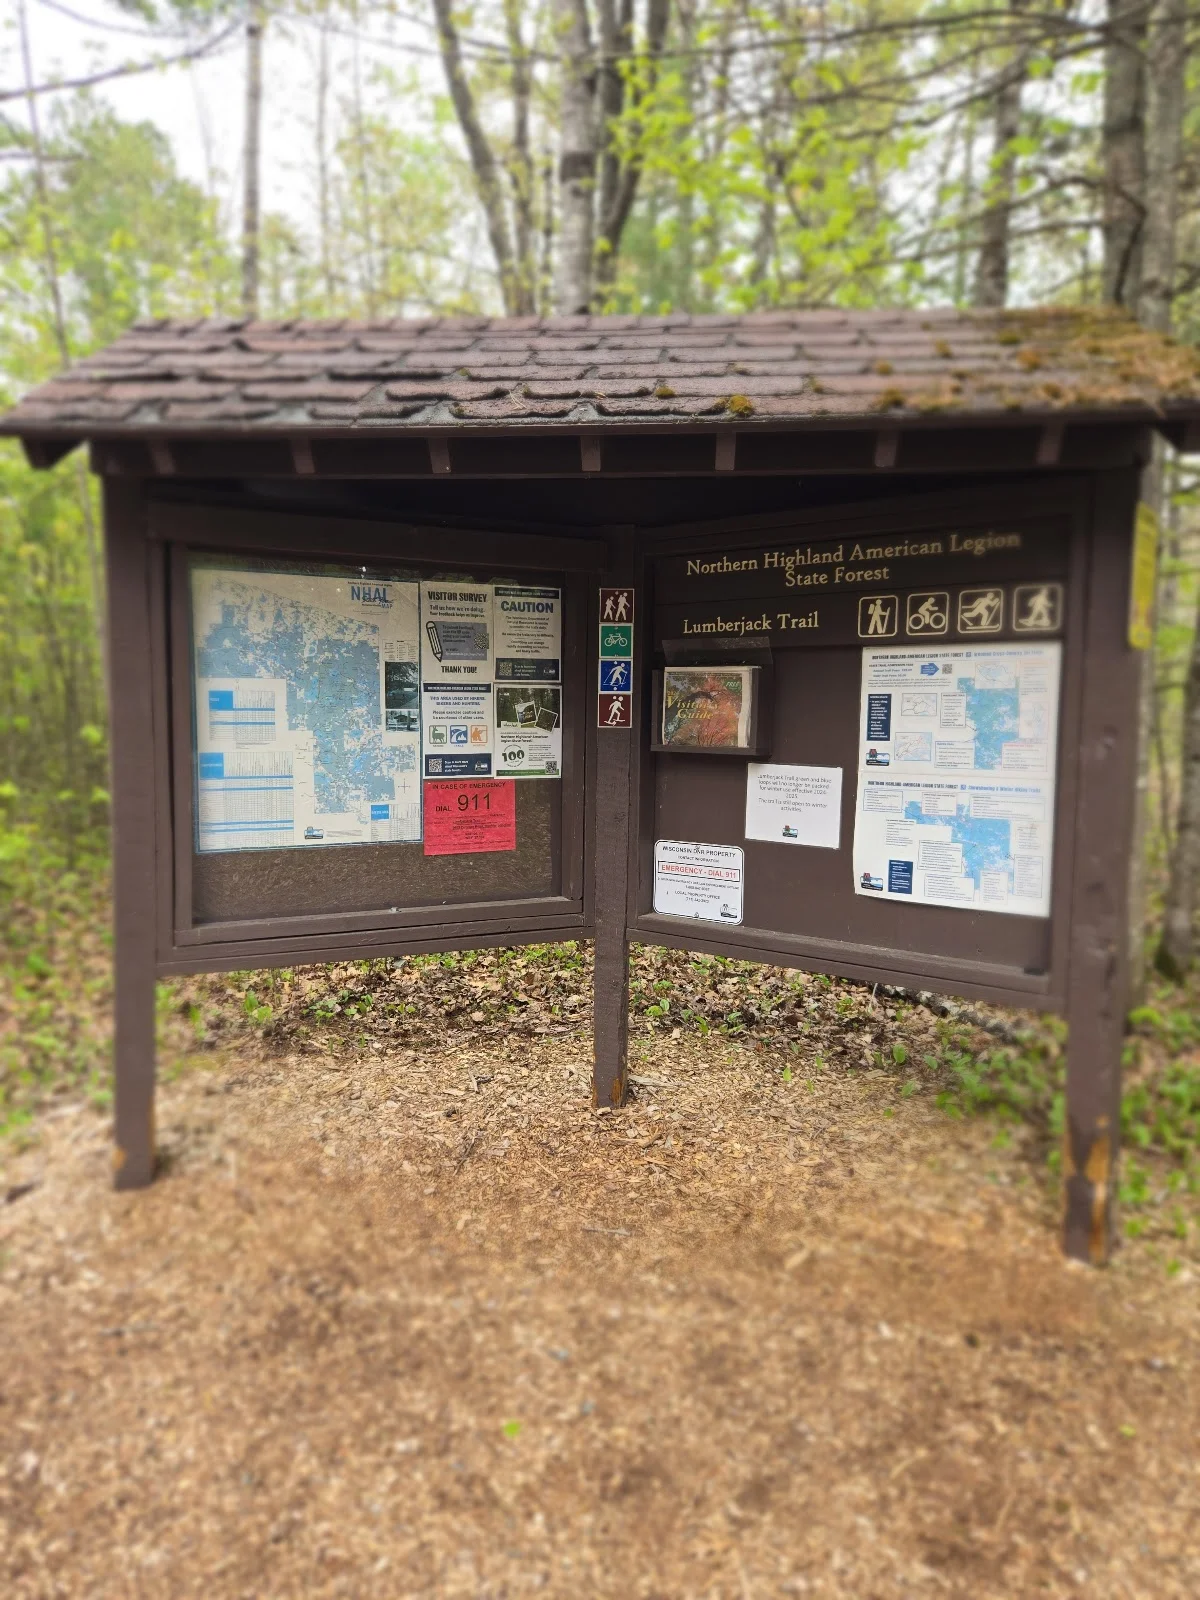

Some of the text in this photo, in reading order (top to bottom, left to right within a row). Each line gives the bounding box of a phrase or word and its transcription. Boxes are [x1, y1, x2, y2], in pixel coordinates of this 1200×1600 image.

[686, 532, 1020, 576] Northern Highland American Legion
[785, 566, 890, 587] State Forest
[428, 591, 458, 601] VISITOR
[458, 592, 487, 603] SURVEY
[501, 600, 554, 613] CAUTION
[683, 610, 819, 636] Lumberjack Trail
[441, 665, 477, 674] THANK YOU!
[677, 708, 714, 719] Guide
[502, 749, 525, 762] 100
[457, 792, 491, 812] 911
[662, 845, 692, 854] WISCONSIN
[705, 850, 736, 858] PROPERTY
[661, 864, 703, 875] EMERGENCY
[708, 869, 724, 878] DIAL
[725, 871, 736, 879] 911
